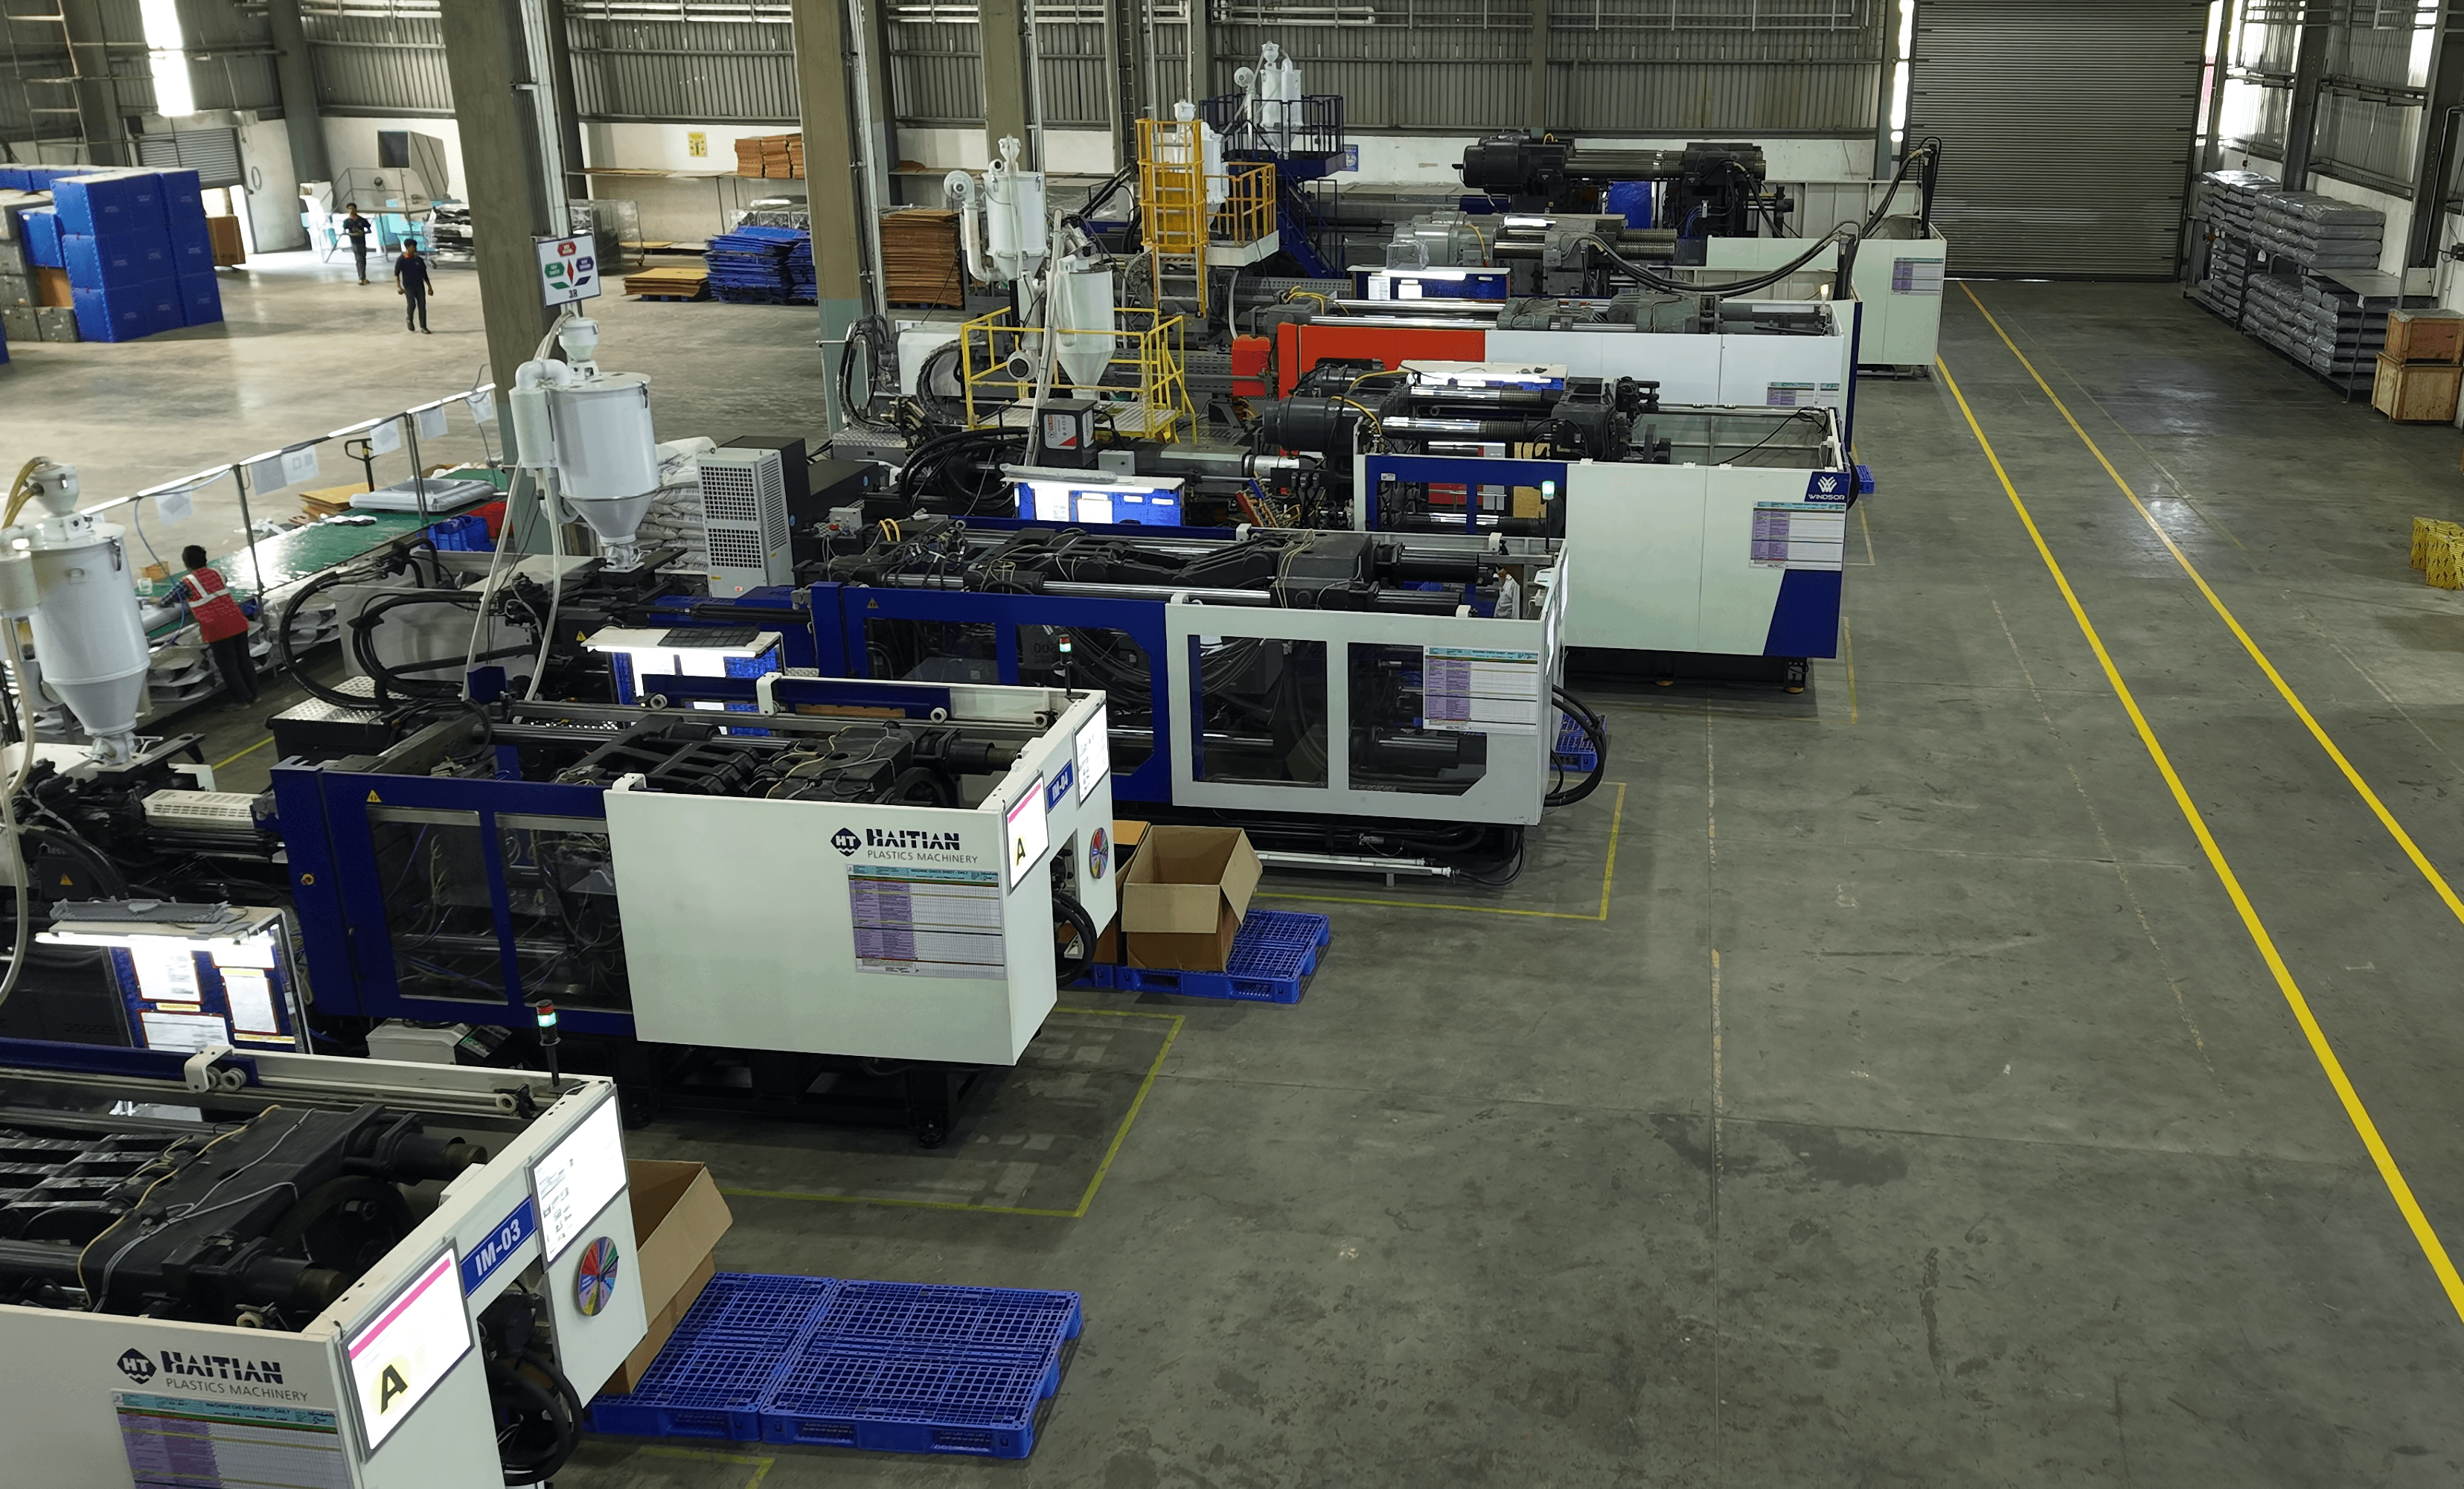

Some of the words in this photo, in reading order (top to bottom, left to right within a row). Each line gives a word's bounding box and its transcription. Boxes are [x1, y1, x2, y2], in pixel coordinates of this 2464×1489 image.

[569, 289, 578, 298] 3R
[835, 835, 857, 848] HT
[865, 828, 960, 851] HAITIAN
[868, 850, 913, 861] PLASTICS
[917, 852, 978, 864] MACHINERY
[1016, 837, 1026, 867] A
[475, 1218, 521, 1278] IM-03
[122, 1357, 149, 1372] HT
[160, 1351, 284, 1385] HAITIAN
[166, 1377, 225, 1394] PLASTICS
[229, 1384, 308, 1402] MACHINERY
[380, 1364, 409, 1416] A
